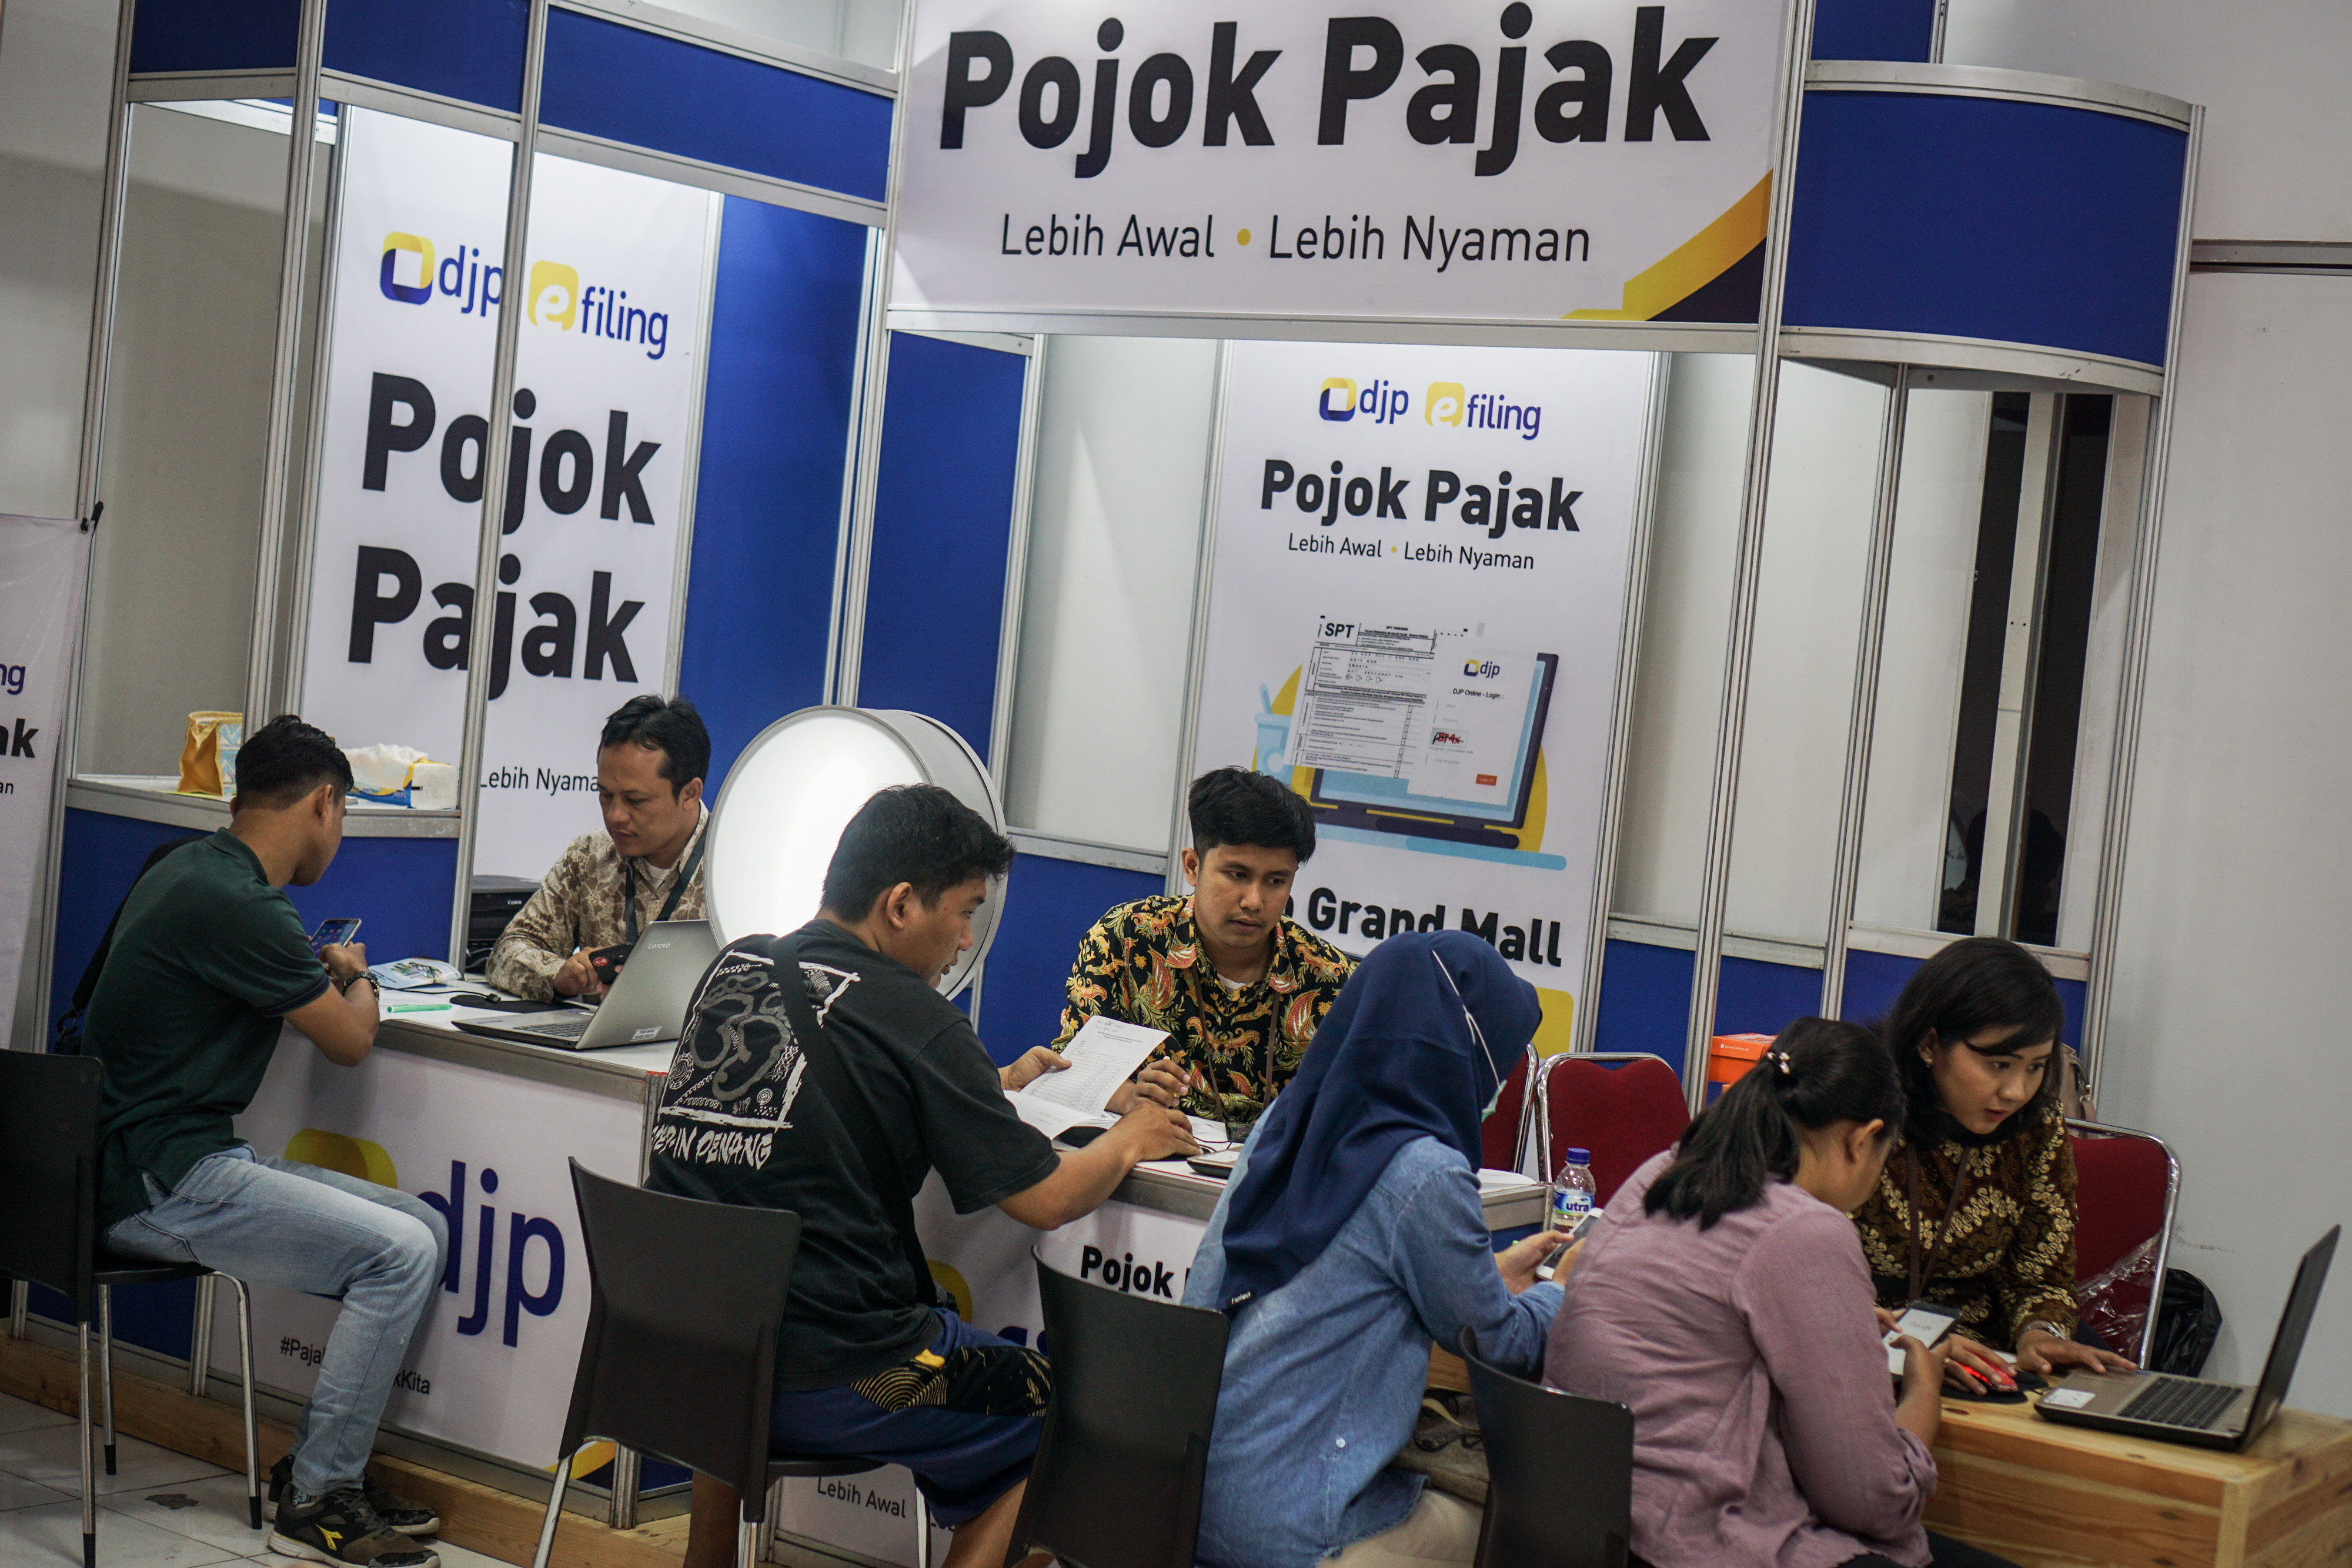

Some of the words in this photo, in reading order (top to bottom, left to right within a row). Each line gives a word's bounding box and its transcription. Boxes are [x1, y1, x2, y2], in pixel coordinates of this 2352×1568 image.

[940, 18, 1283, 179] Pojok
[1317, 1, 1720, 177] Pajak
[1002, 213, 1104, 256] Lebih
[1117, 214, 1215, 258] Awal
[1269, 214, 1384, 260] Lebih
[1403, 215, 1589, 273] Nyaman
[437, 245, 503, 316] djp
[581, 286, 668, 360] filing
[1359, 379, 1409, 424] djp
[1467, 393, 1541, 441] filing
[362, 372, 662, 535] Pojok
[1261, 459, 1411, 527] Pojok
[1424, 469, 1583, 539] Pajak
[1289, 533, 1334, 554] Lebih
[1339, 537, 1382, 557] Awal
[1404, 541, 1452, 563] Lebih
[1459, 546, 1534, 570] Nyaman
[348, 545, 645, 700] Pajak
[1325, 623, 1355, 638] SPT
[1452, 687, 1465, 696] DJP
[1465, 689, 1482, 698] Online
[1486, 691, 1501, 701] Login
[1479, 661, 1500, 679] djp
[480, 765, 529, 789] ebih
[536, 767, 599, 795] Nyama
[1308, 887, 1445, 940] Grand
[1461, 908, 1562, 967] Mall
[696, 1130, 770, 1171] PENANG
[1080, 1245, 1175, 1298] Pojok
[817, 1476, 861, 1505] Lebih
[865, 1489, 906, 1519] Awal
